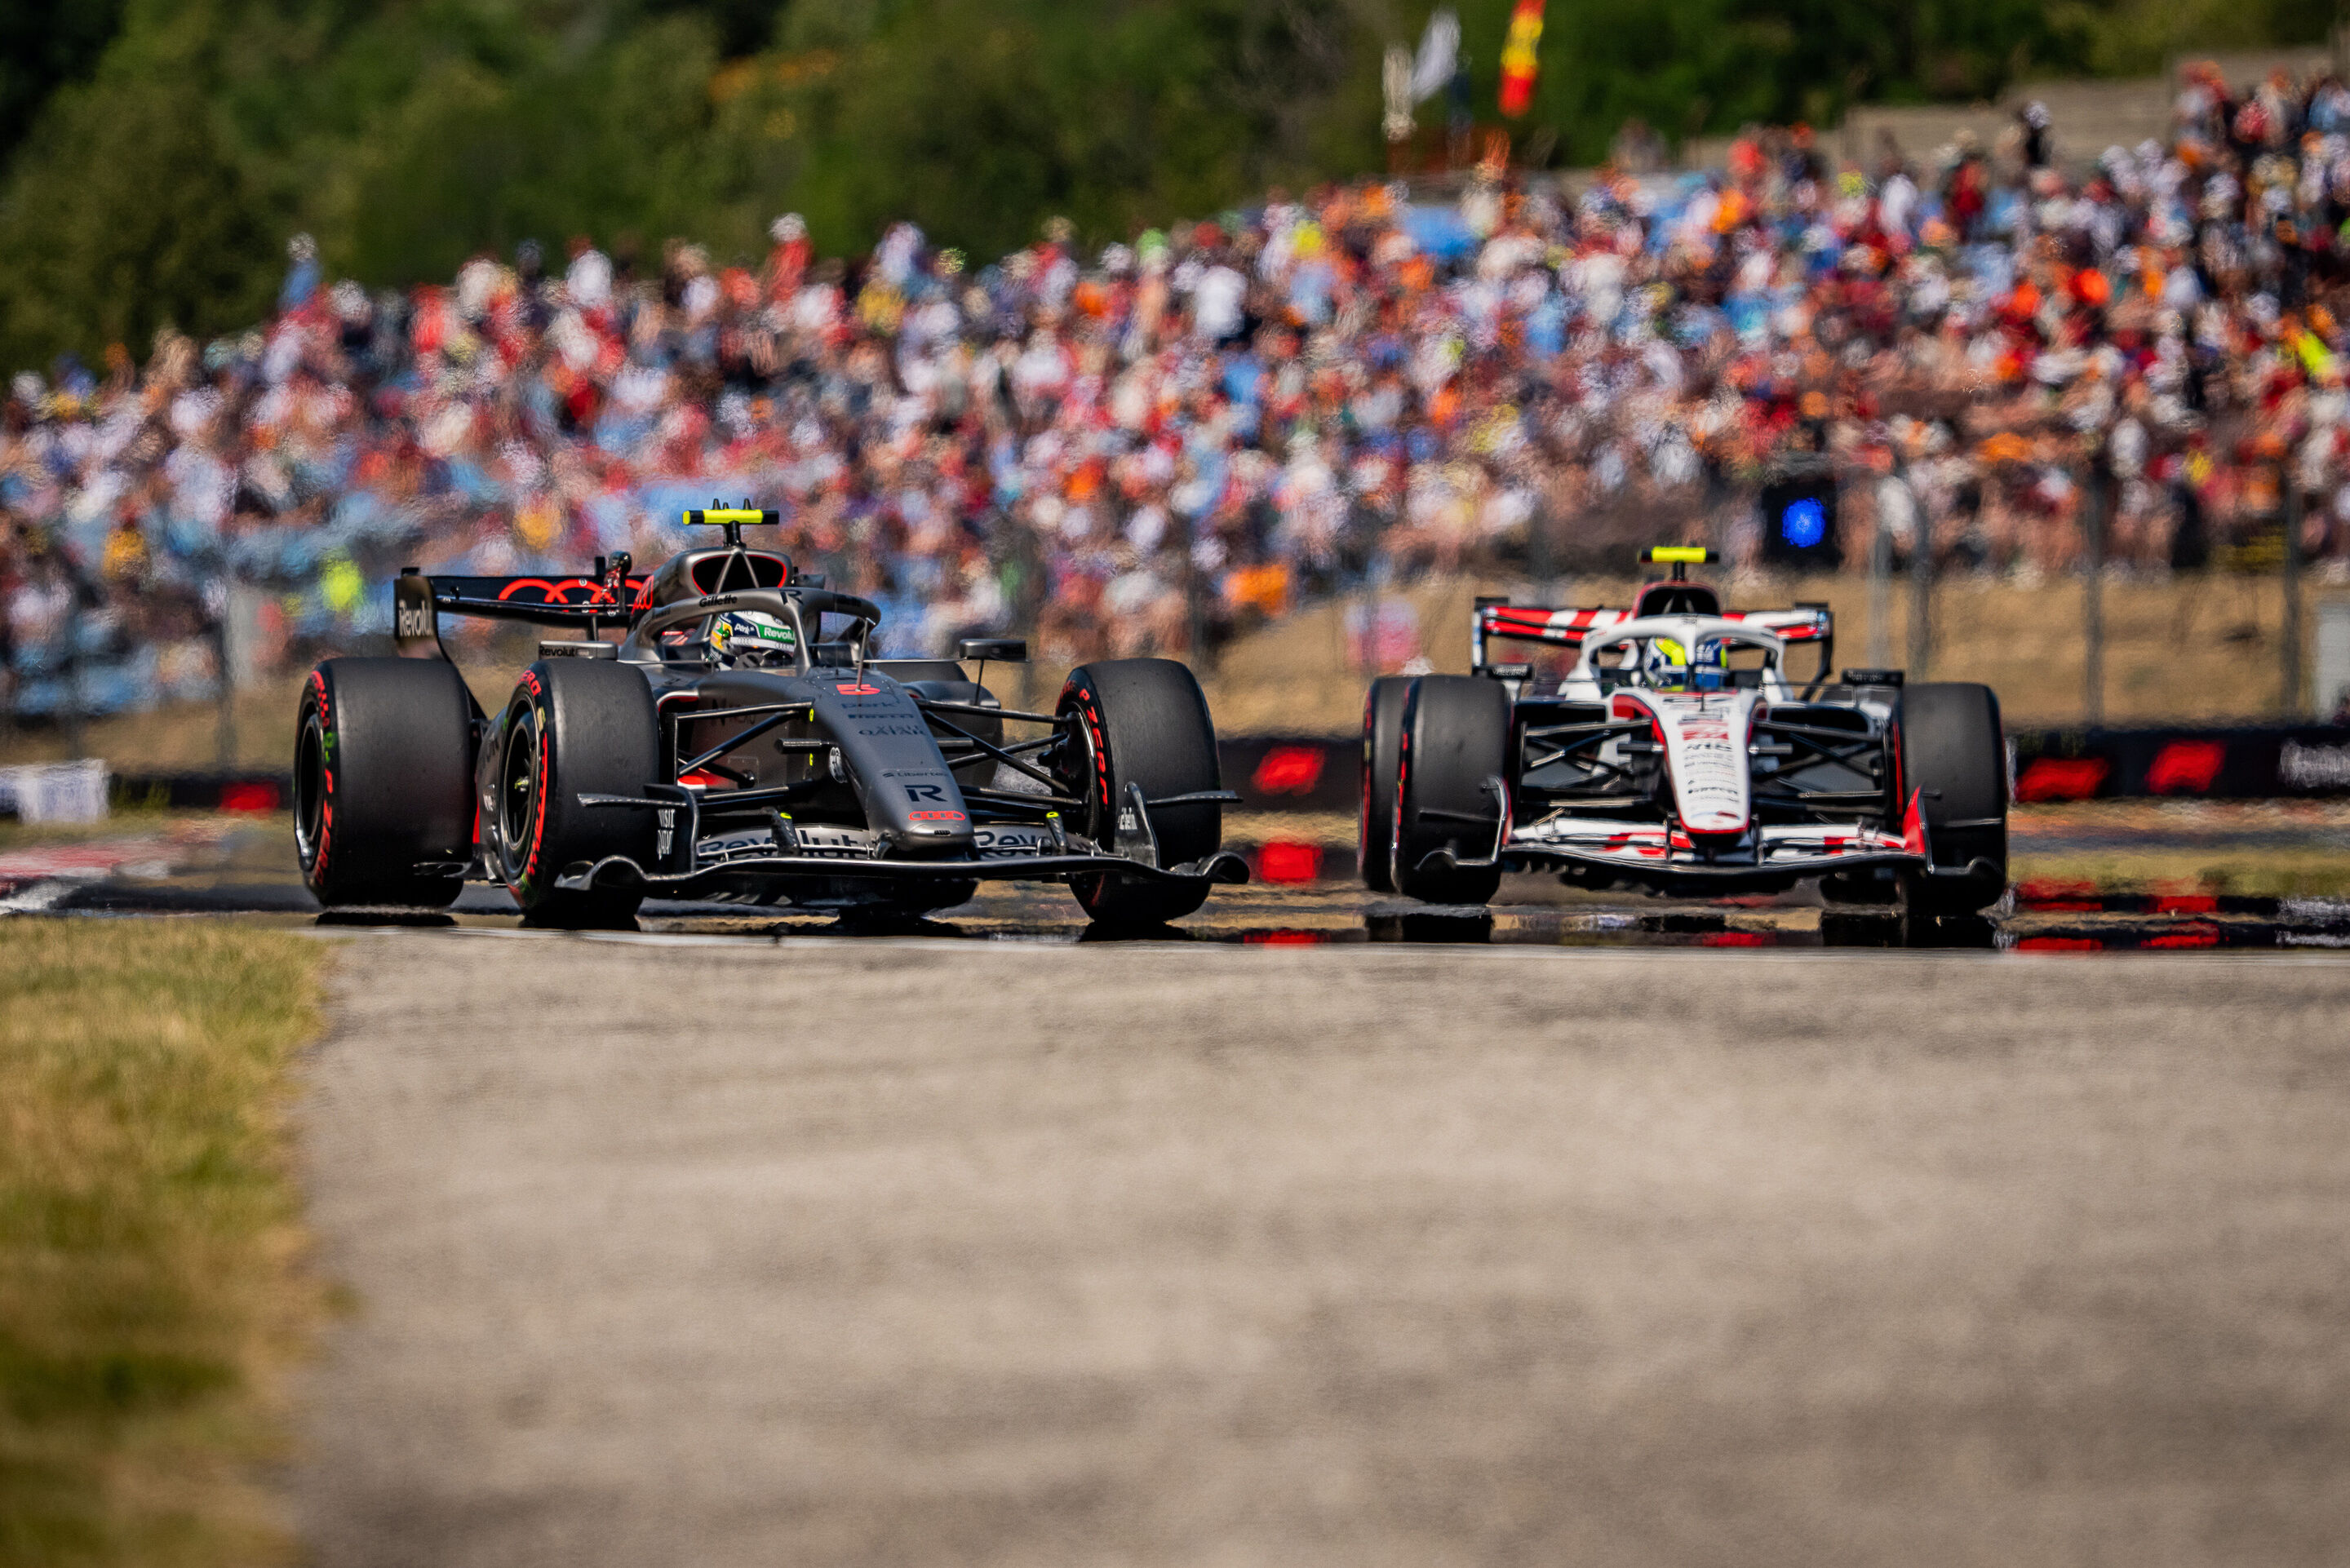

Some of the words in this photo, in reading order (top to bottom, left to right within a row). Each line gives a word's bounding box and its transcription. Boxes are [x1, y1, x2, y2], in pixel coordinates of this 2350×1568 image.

[698, 595, 738, 607] Gillette
[398, 598, 434, 637] Revolu
[764, 627, 796, 640] Revolu
[539, 645, 575, 657] Revolut
[836, 684, 881, 695] 5
[904, 785, 948, 802] R
[698, 829, 858, 858] Revlut
